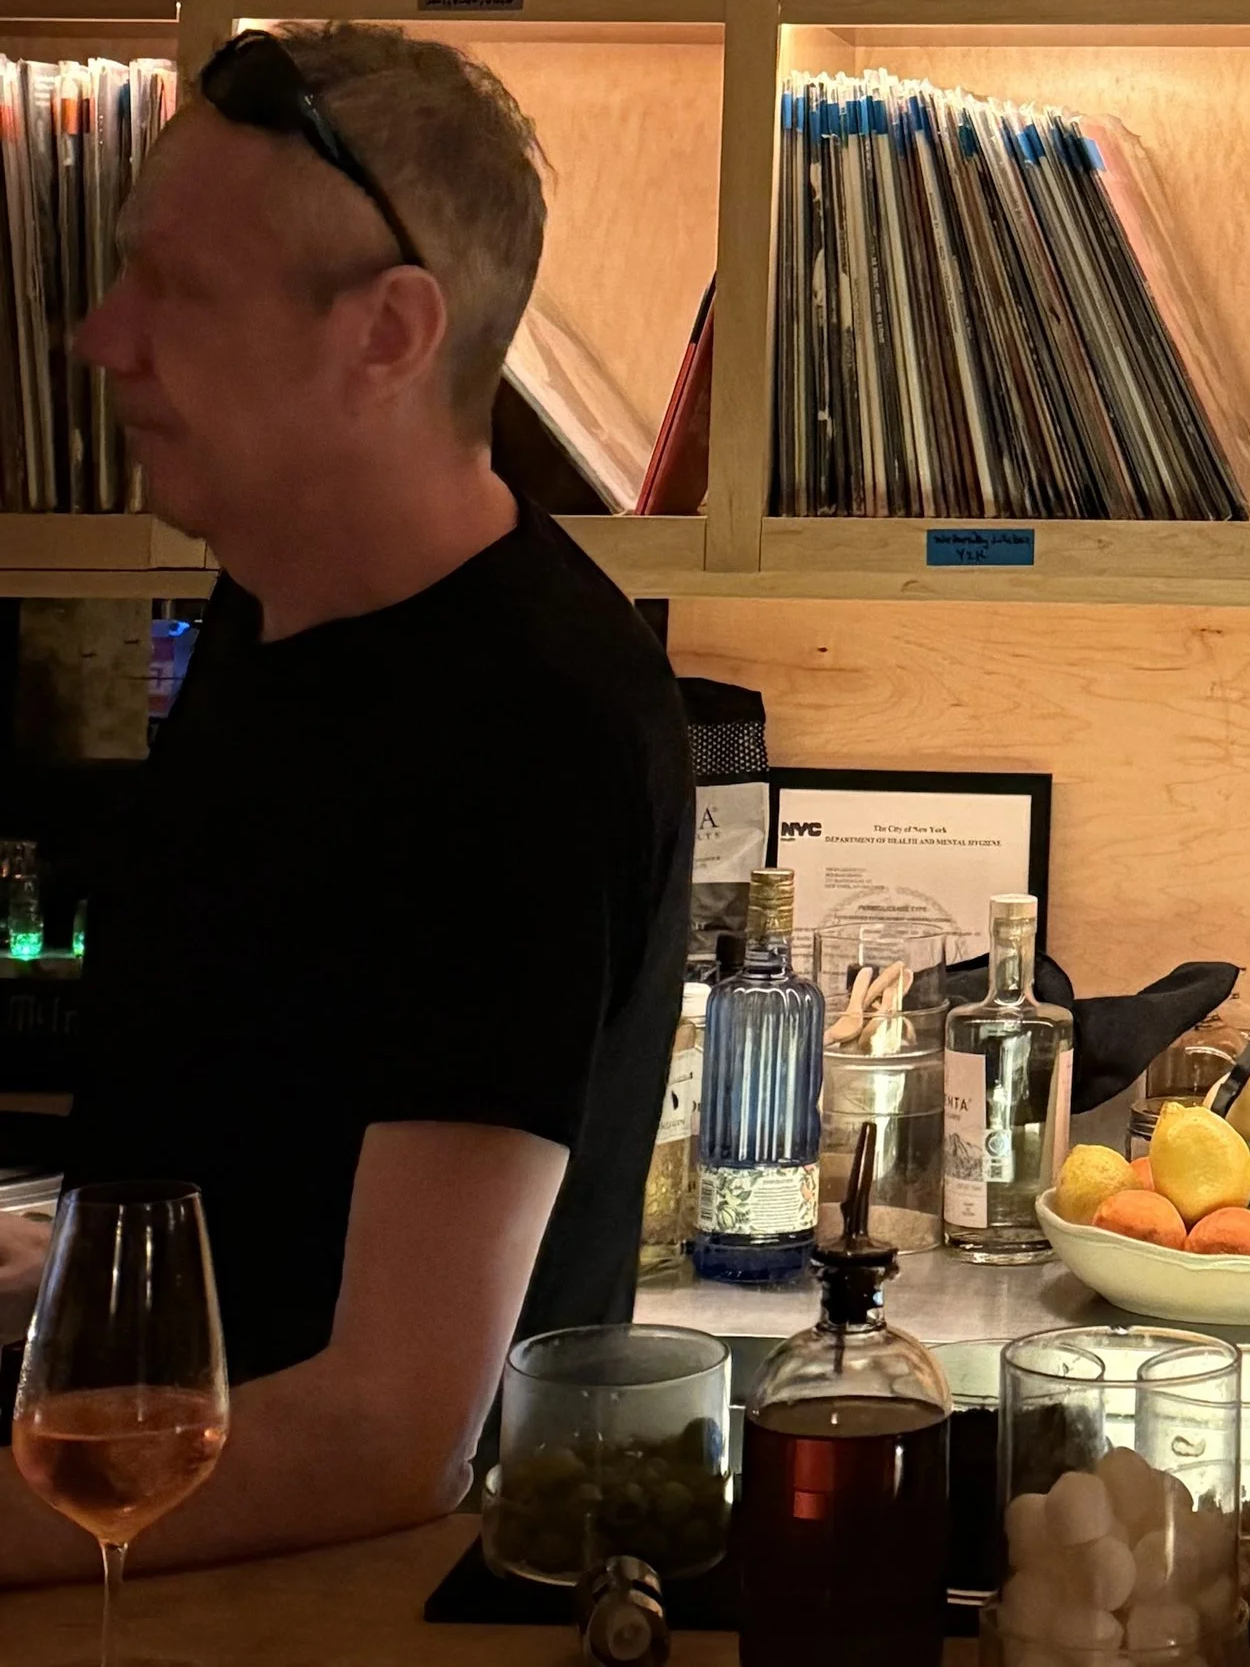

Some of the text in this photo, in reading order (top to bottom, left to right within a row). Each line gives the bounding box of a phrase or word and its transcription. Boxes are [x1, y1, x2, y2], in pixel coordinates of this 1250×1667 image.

[781, 821, 822, 837] NYC
[888, 825, 902, 834] City
[825, 836, 875, 844] DEPARTMENT
